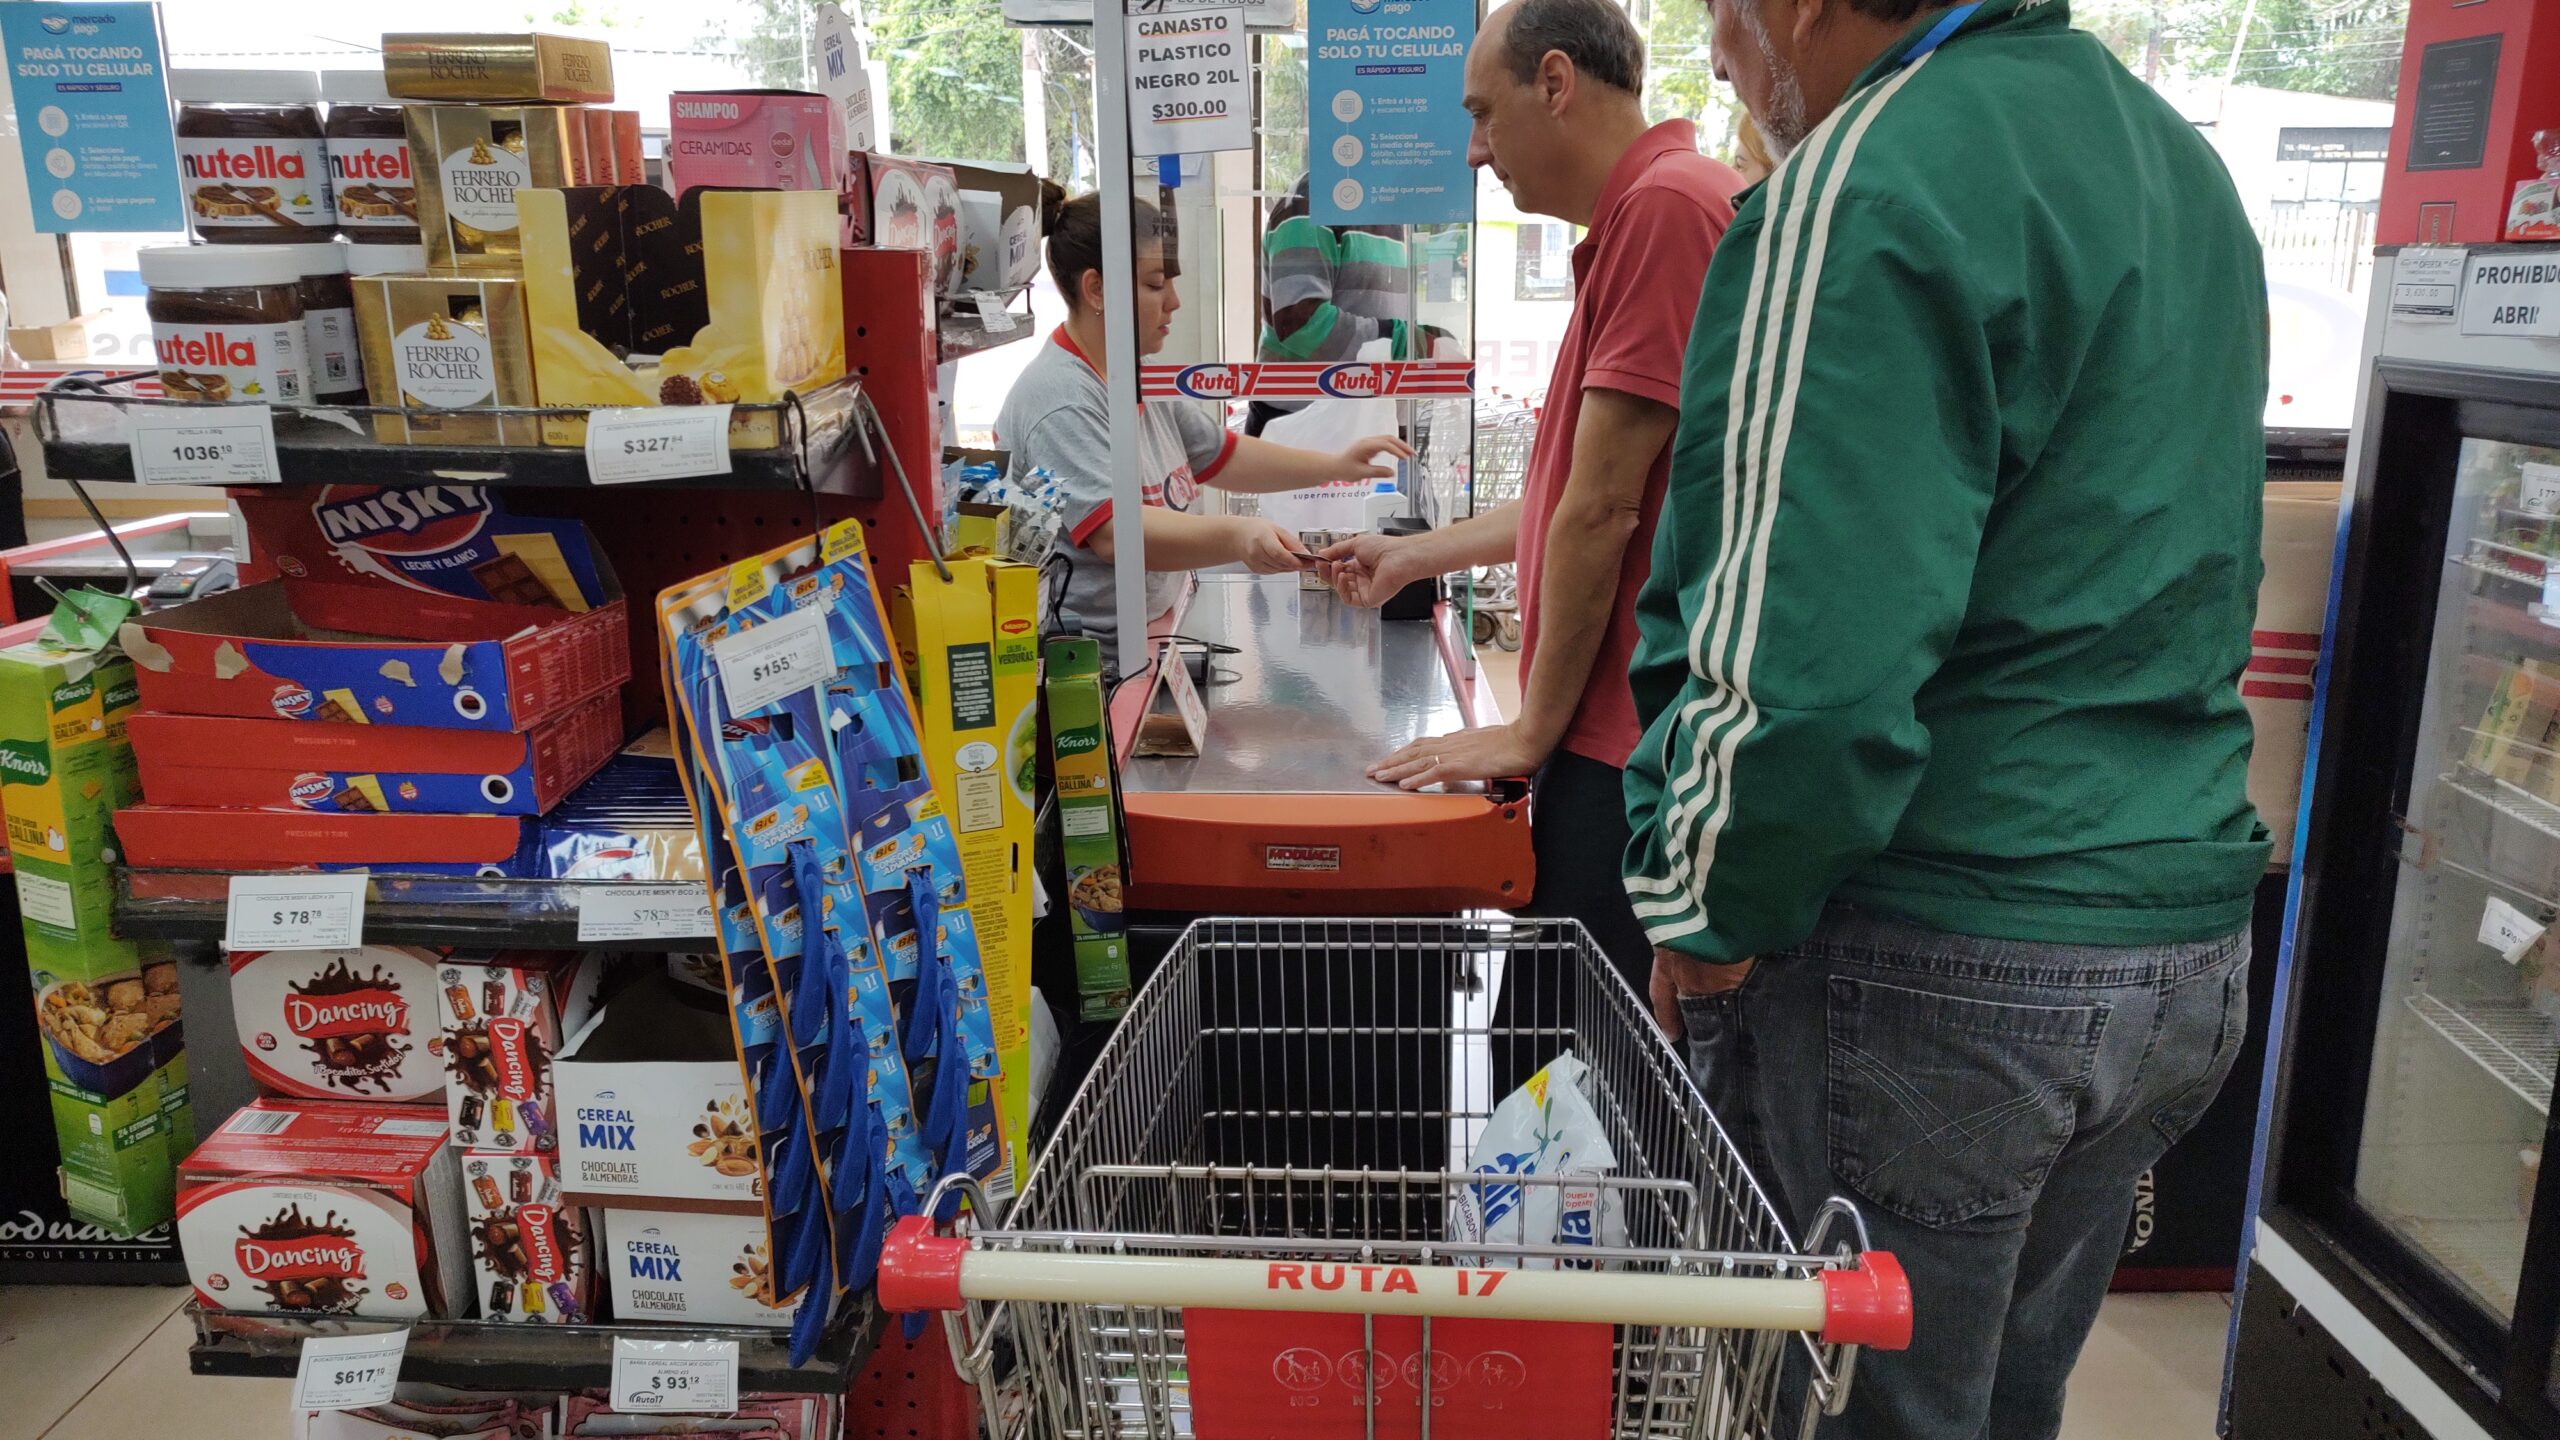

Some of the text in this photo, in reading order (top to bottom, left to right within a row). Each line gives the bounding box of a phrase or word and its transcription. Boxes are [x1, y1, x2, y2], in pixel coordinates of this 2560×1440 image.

[1384, 4, 1411, 14] pago
[1138, 16, 1228, 36] CANASTO
[1327, 25, 1455, 41] PAGÁ TOCANDO
[824, 32, 842, 51] CEREAL
[68, 47, 142, 59] TOCANDO
[428, 51, 487, 65] FERRERO
[1139, 43, 1231, 63] PLASTICO
[1318, 43, 1463, 59] SOLO TU CELULAR
[561, 53, 591, 68] FERRERO
[826, 48, 846, 82] MIX
[18, 63, 153, 77] SOLO TU CELULAR
[430, 65, 489, 80] ROCHER
[564, 68, 592, 83] ROCHER
[1366, 66, 1390, 74] RÁPIDO
[1135, 70, 1240, 90] NEGRO 20L
[677, 102, 739, 119] SHAMPOO
[1152, 100, 1227, 119] $300.00
[679, 141, 753, 156] CERAMIDAS
[182, 145, 305, 179] nutella
[451, 170, 520, 187] FERRERO
[453, 184, 515, 204] ROCHE
[2476, 265, 2560, 284] PROHIBID
[405, 346, 480, 363] FERRERO
[408, 363, 484, 380] ROCHER
[1192, 364, 1260, 396] Ruta 17
[1334, 364, 1403, 396] Ruta 17
[323, 485, 480, 538] MISKY
[402, 549, 479, 571] LECHE Y BLANCO
[796, 579, 817, 595] BIC
[831, 573, 844, 590] 3
[706, 625, 728, 643] BIC
[998, 651, 1034, 665] VERDURAS
[274, 692, 311, 707] MISKY
[54, 724, 87, 740] GALLINA
[1056, 736, 1097, 749] Knorr
[0, 750, 48, 777] Knorr
[292, 780, 332, 797] MISKY
[1059, 779, 1092, 791] GALLINA
[754, 804, 809, 832] BIC 3
[9, 824, 46, 847] GALLINA
[764, 822, 806, 850] ADVANCE
[874, 834, 926, 860] BIC 3
[884, 849, 923, 876] ADVANCE
[605, 889, 651, 897] CHOCOLATE
[273, 912, 283, 925] $
[289, 999, 400, 1031] Dancing
[494, 1022, 524, 1099] Dancing
[577, 1108, 634, 1123] CEREAL
[118, 1127, 128, 1139] 24
[129, 1136, 135, 1144] 2
[579, 1123, 636, 1151] MIX
[581, 1161, 638, 1174] CHOCOLATE
[522, 1208, 554, 1282] Dancing
[627, 1241, 679, 1256] CEREAL
[79, 1251, 161, 1261] SYSTEM
[240, 1244, 358, 1274] Dancing
[629, 1255, 682, 1282] MIX
[1268, 1263, 1509, 1297] RUTA 17
[632, 1289, 686, 1303] CHOCOLATE
[651, 1376, 661, 1389] $
